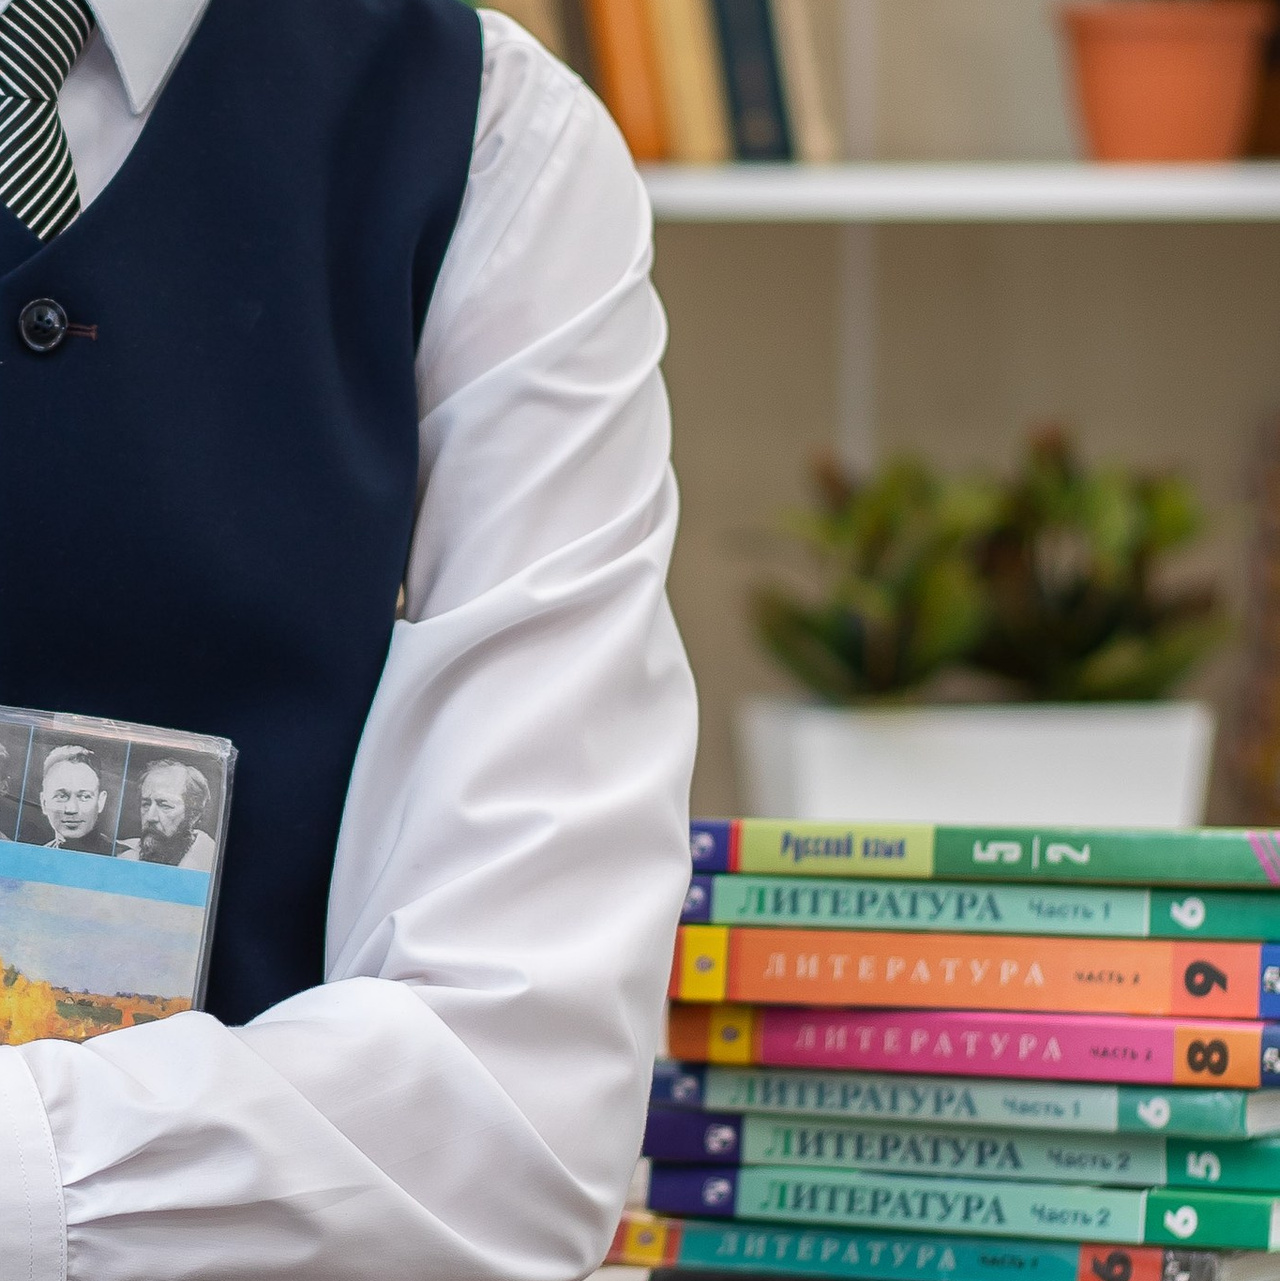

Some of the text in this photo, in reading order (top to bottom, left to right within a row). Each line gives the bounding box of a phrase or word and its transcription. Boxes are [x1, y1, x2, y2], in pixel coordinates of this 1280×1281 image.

[973, 840, 1090, 864] 5 2
[738, 886, 1002, 921] ЛИТЕРАТУРА
[1028, 898, 1094, 920] Часть
[1170, 897, 1206, 930] 6
[763, 952, 1044, 987] ЛИТЕРАТУРА
[1184, 960, 1228, 998] 9
[794, 1023, 1062, 1062] ЛИТЕРАТУРА
[1186, 1038, 1229, 1076] 8
[728, 1076, 978, 1117] ЛИТЕРАТУРА
[1137, 1096, 1171, 1129] 6
[764, 1126, 1022, 1170] ЛИТЕРАТУРА
[1047, 1146, 1112, 1170] Часть
[1186, 1150, 1221, 1183] 5
[760, 1179, 1111, 1228] ЛИТЕРАТУРА Часть 2
[1164, 1205, 1198, 1239] 6
[717, 1231, 956, 1272] ЛИТЕРАТУРА
